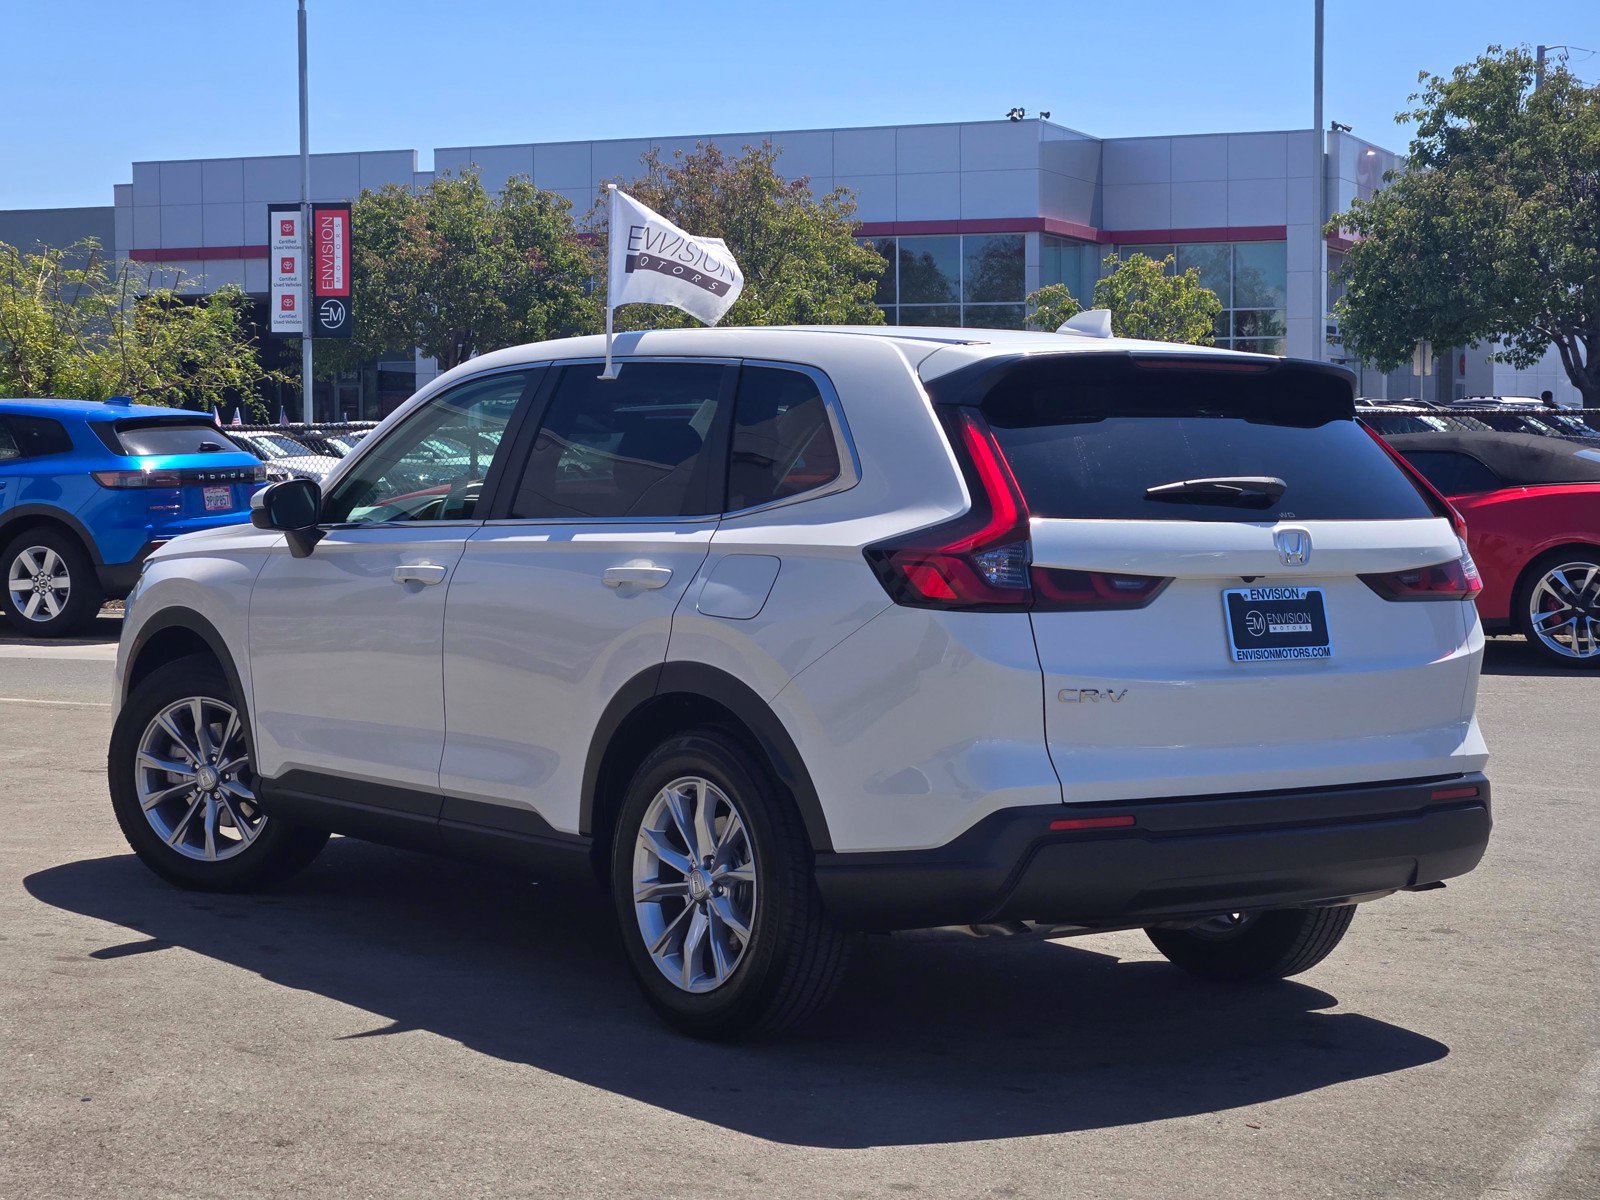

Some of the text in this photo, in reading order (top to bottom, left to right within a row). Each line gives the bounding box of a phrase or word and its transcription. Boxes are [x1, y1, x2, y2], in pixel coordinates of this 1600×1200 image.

[322, 216, 334, 290] ENVISION
[627, 225, 736, 282] ENVISION
[638, 255, 719, 291] OTORS
[1273, 511, 1296, 519] WD
[1250, 588, 1300, 600] ENVISION
[1266, 612, 1312, 624] ENVISION
[1236, 646, 1331, 661] ENVISIONMOTORS.COM
[1057, 688, 1128, 704] CR-V
